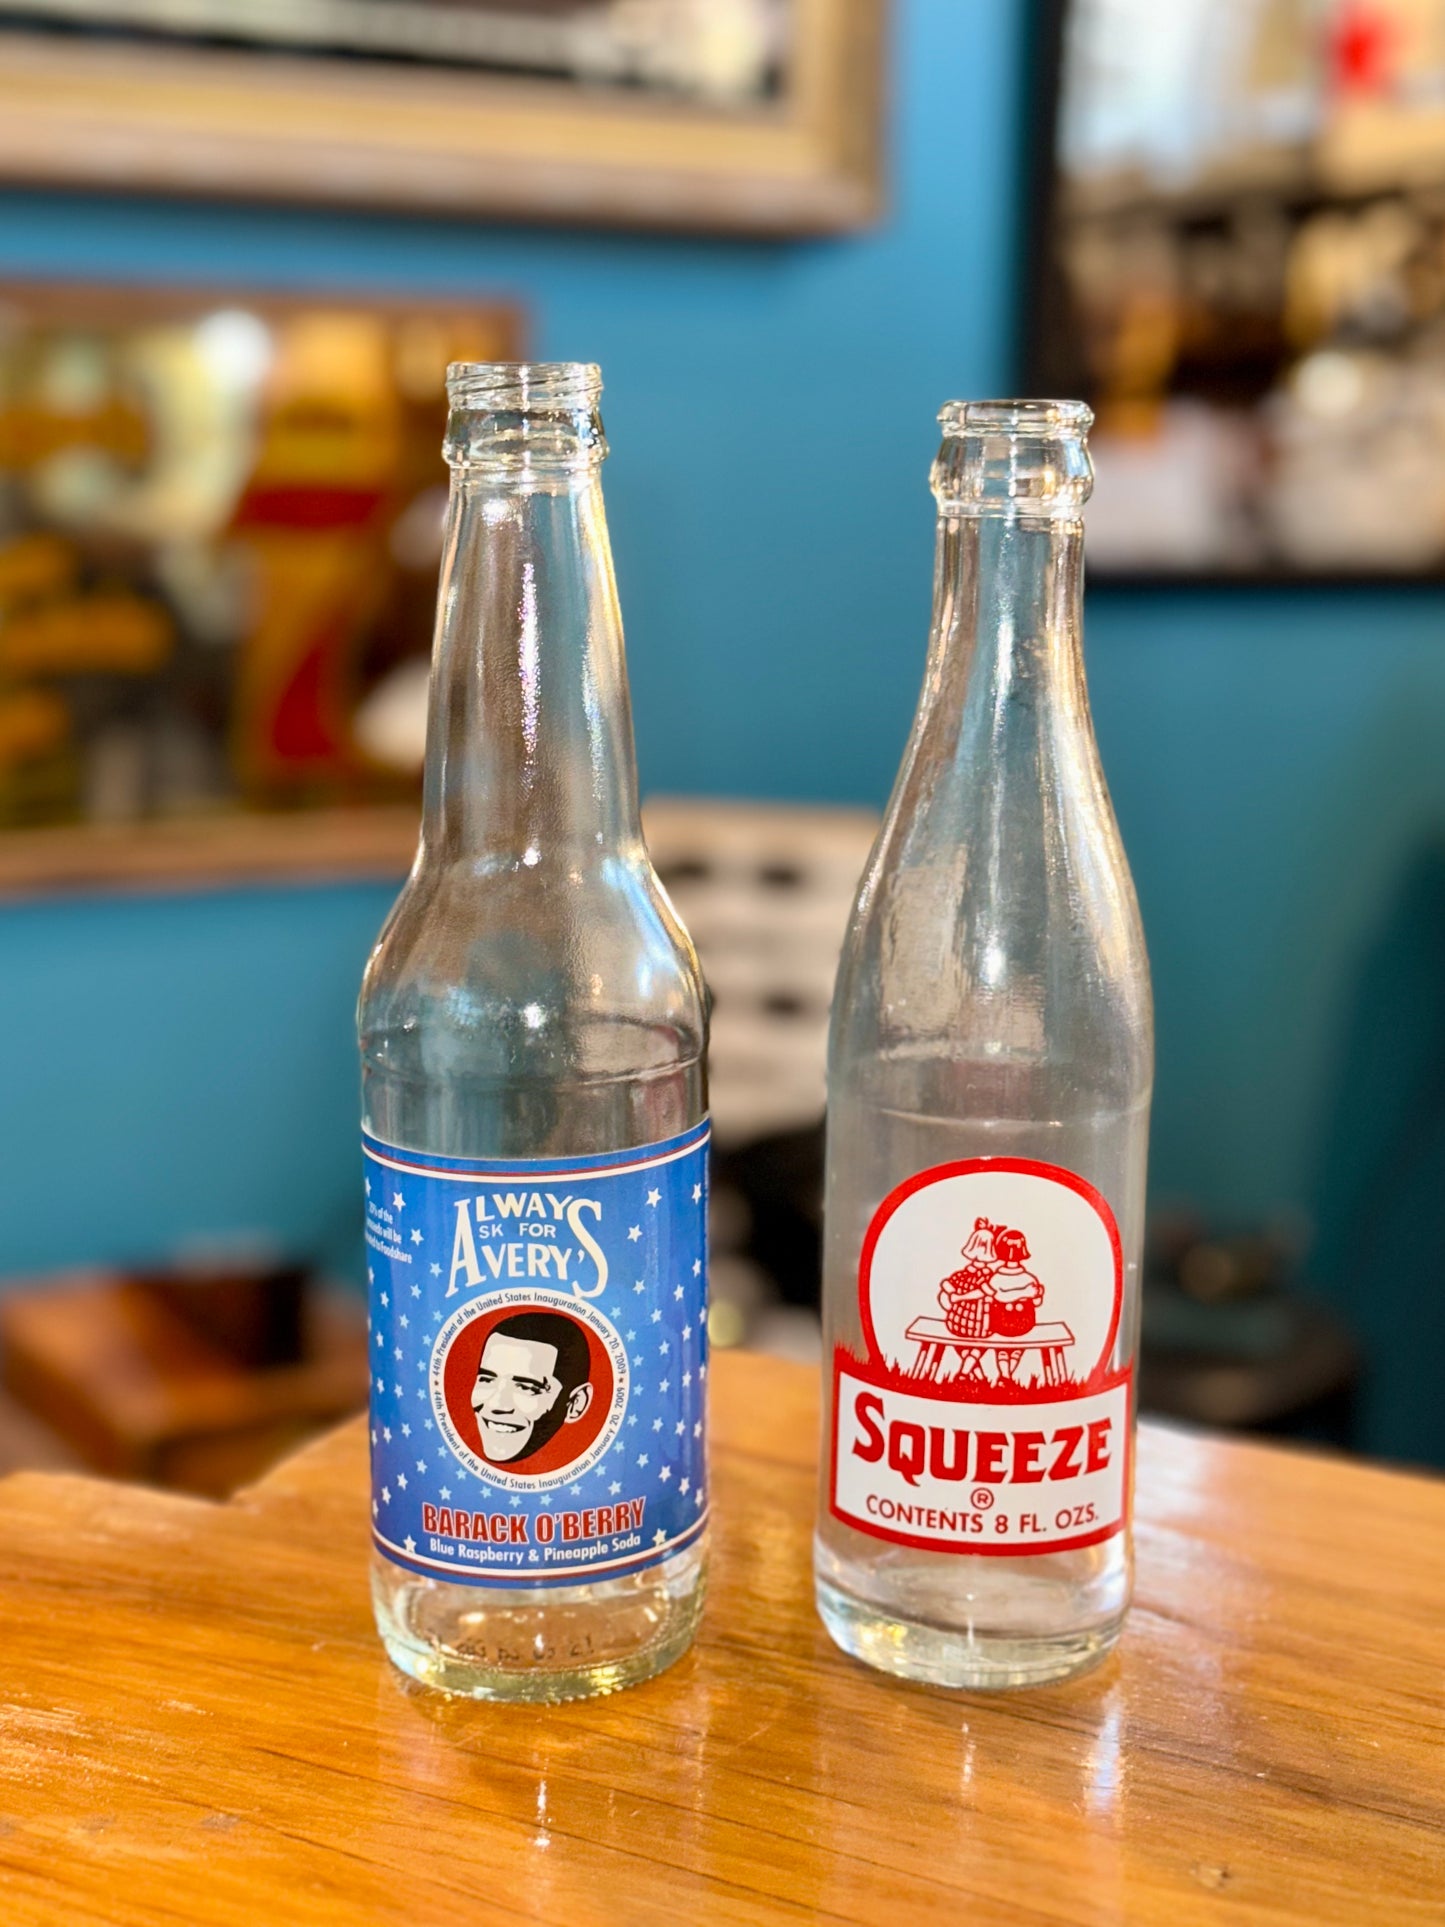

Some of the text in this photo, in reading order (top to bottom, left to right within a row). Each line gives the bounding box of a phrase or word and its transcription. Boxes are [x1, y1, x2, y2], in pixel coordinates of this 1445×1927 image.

[518, 1223, 557, 1239] FOR
[436, 1323, 458, 1357] President
[456, 1313, 465, 1325] of
[463, 1307, 477, 1319] the
[475, 1294, 503, 1311] United
[504, 1293, 532, 1303] States
[534, 1292, 587, 1316] Inauguration
[586, 1311, 611, 1339] January
[614, 1353, 627, 1374] 2009
[438, 1412, 461, 1450] President
[458, 1451, 469, 1460] of
[467, 1458, 479, 1472] the
[480, 1468, 508, 1486] United
[510, 1478, 536, 1490] States
[538, 1459, 592, 1488] Inauguration
[590, 1428, 615, 1460] January
[614, 1387, 626, 1409] 2009
[852, 1390, 1113, 1487] SQUEEZE
[422, 1495, 647, 1545] BARACK O'BERRY
[866, 1494, 1100, 1534] CONTENTS 8 FL. OZS.
[429, 1533, 641, 1565] Blue Raspberry & Pineapple Soda
